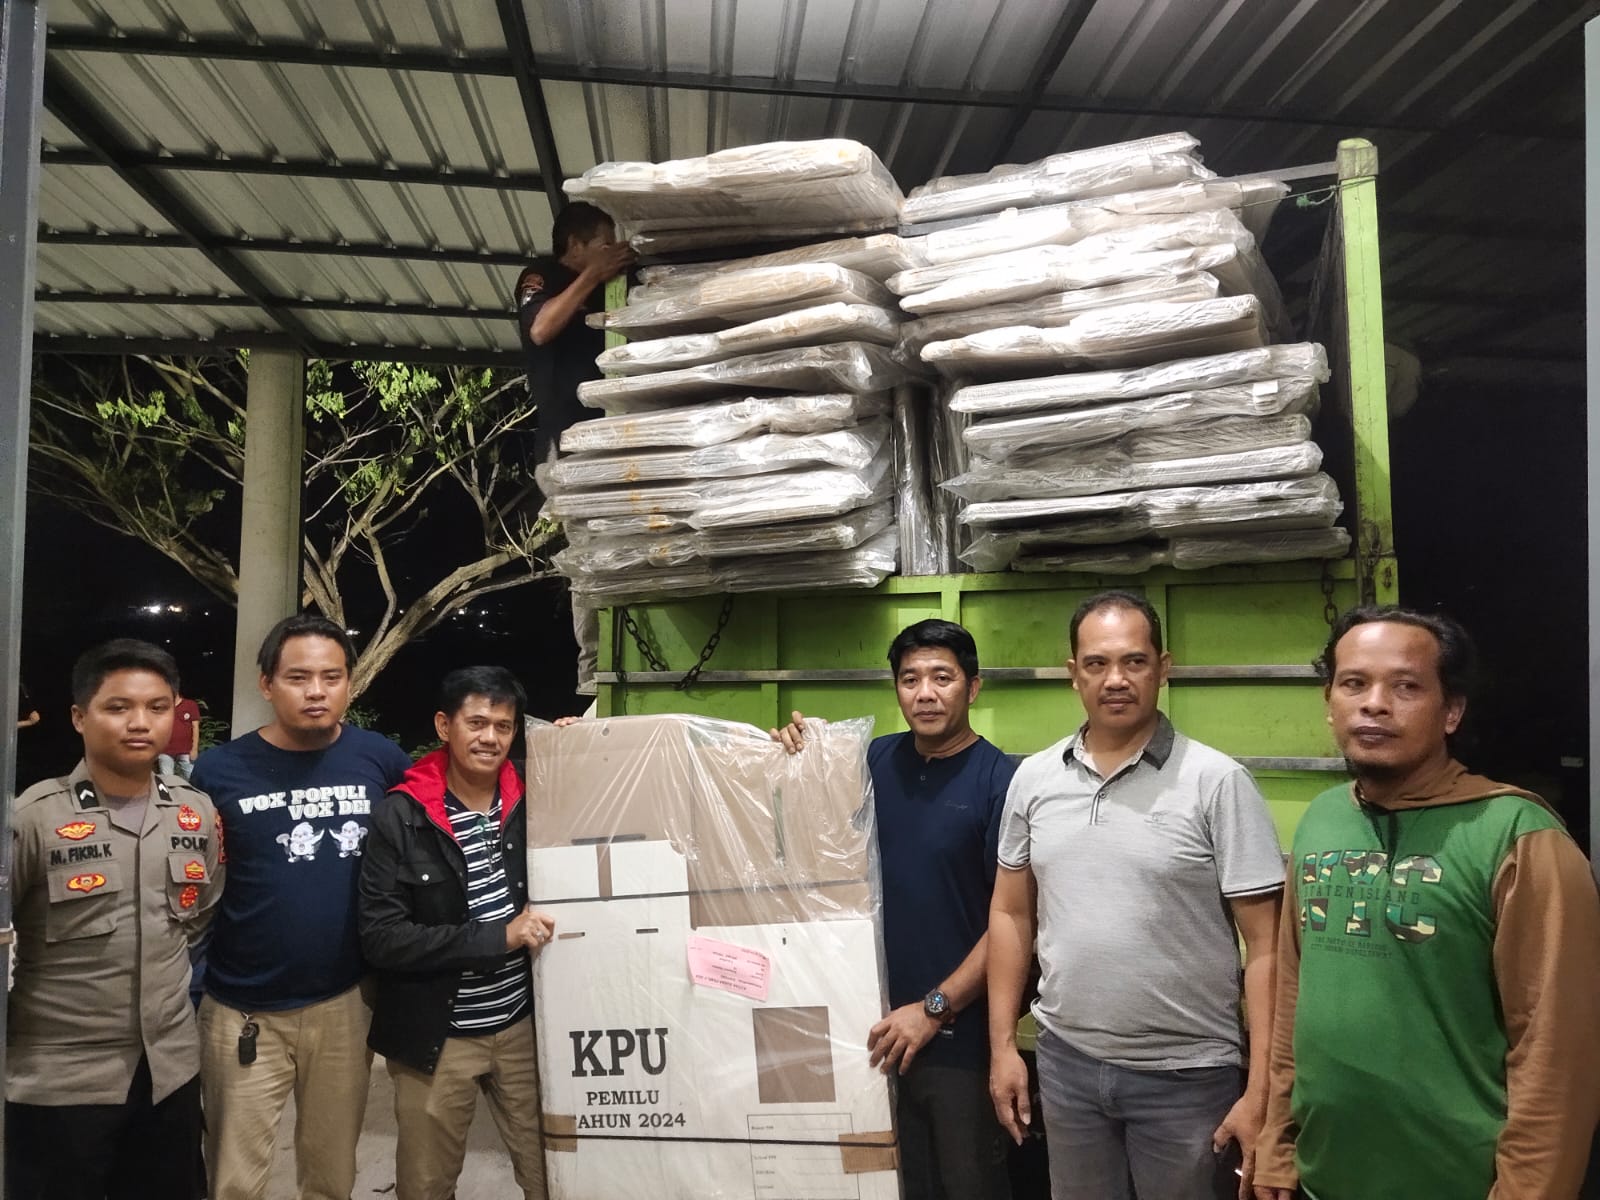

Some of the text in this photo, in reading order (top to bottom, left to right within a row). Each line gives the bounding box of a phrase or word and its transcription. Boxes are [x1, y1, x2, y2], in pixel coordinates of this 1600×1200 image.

[238, 785, 366, 815] VOX POPULI
[288, 799, 371, 820] VOX DEI
[1359, 886, 1420, 904] ISLAND
[569, 1027, 668, 1077] KPU
[585, 1090, 659, 1106] PEMILU
[576, 1112, 686, 1129] AHUN 2024
